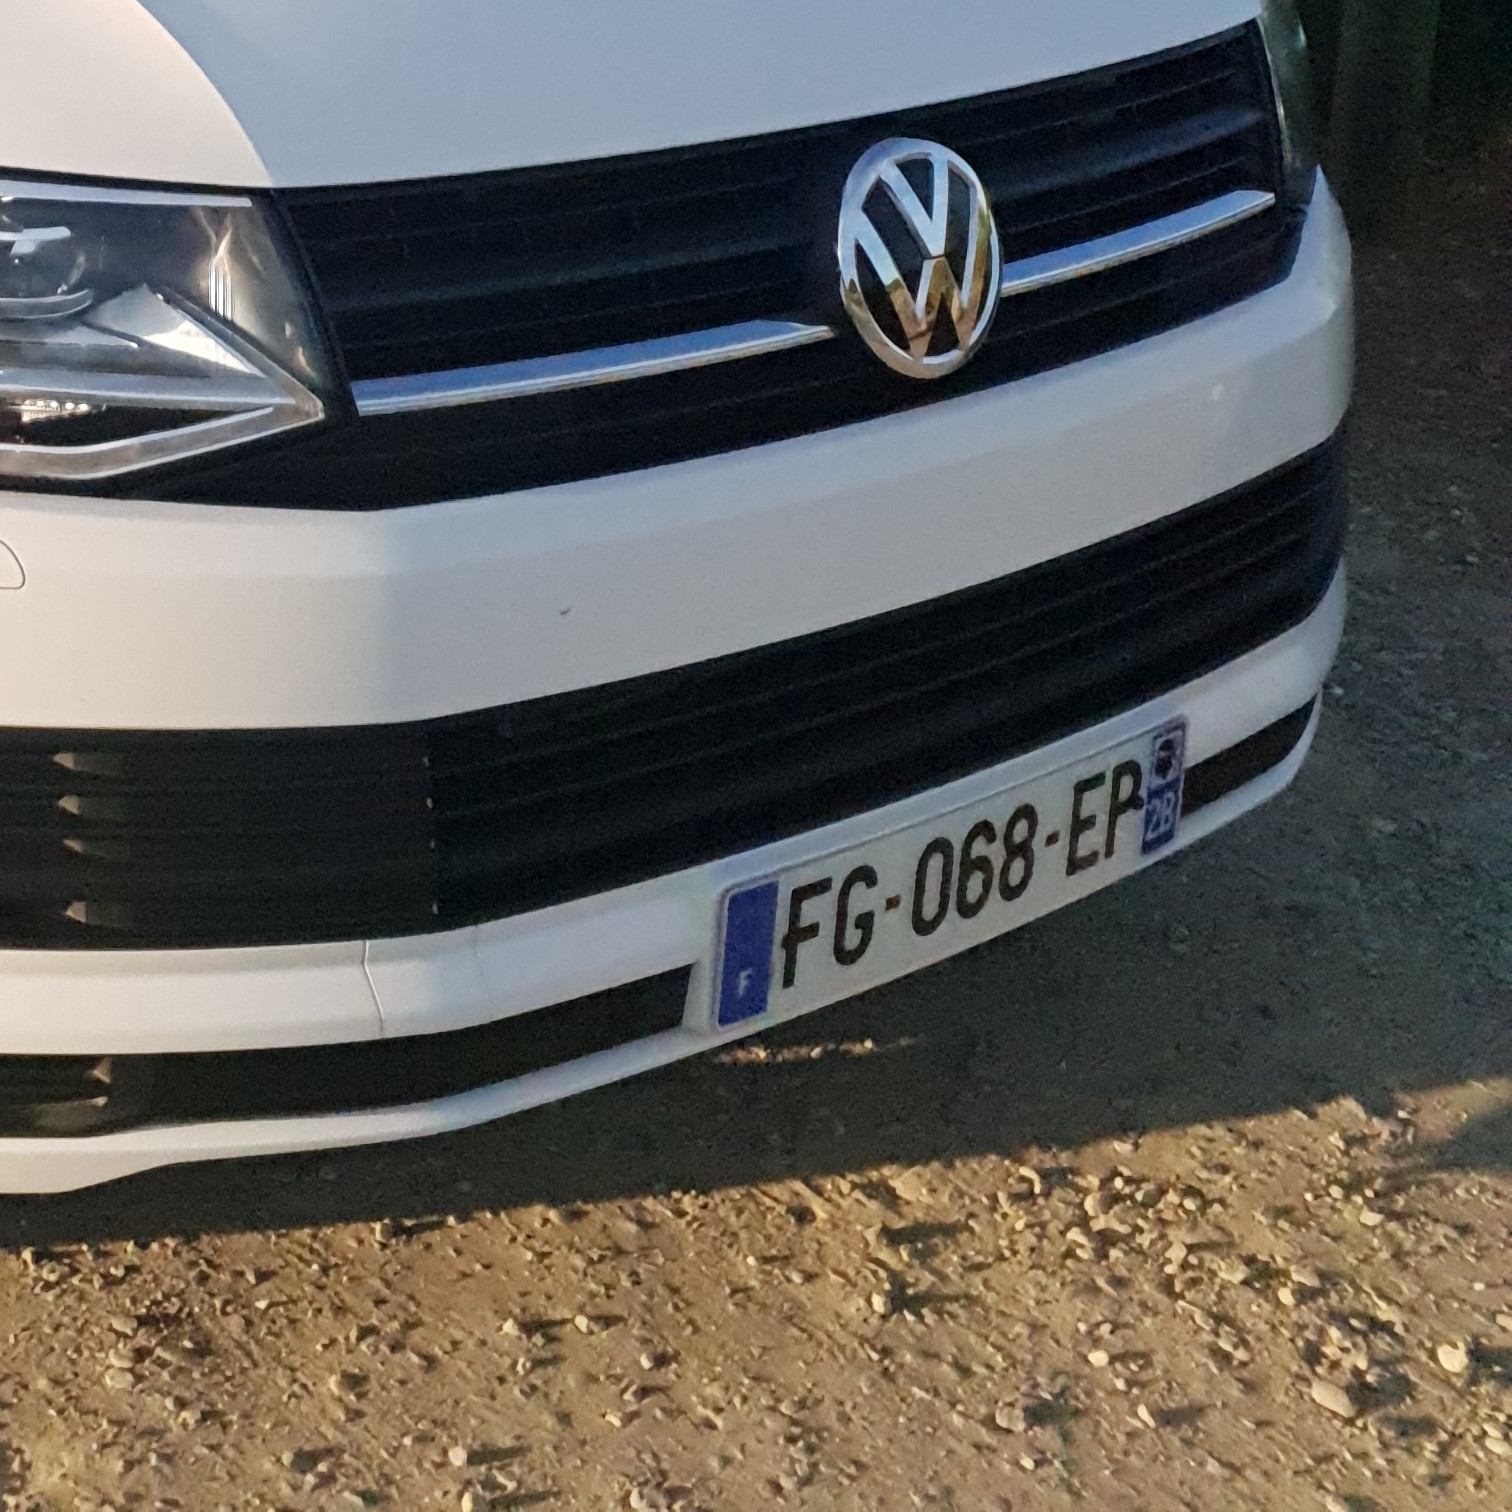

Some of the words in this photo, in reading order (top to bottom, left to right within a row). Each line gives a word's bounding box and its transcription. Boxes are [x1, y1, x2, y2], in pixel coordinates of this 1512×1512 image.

[845, 146, 991, 368] VW
[737, 967, 753, 997] F
[781, 759, 1145, 988] FG-068-EP
